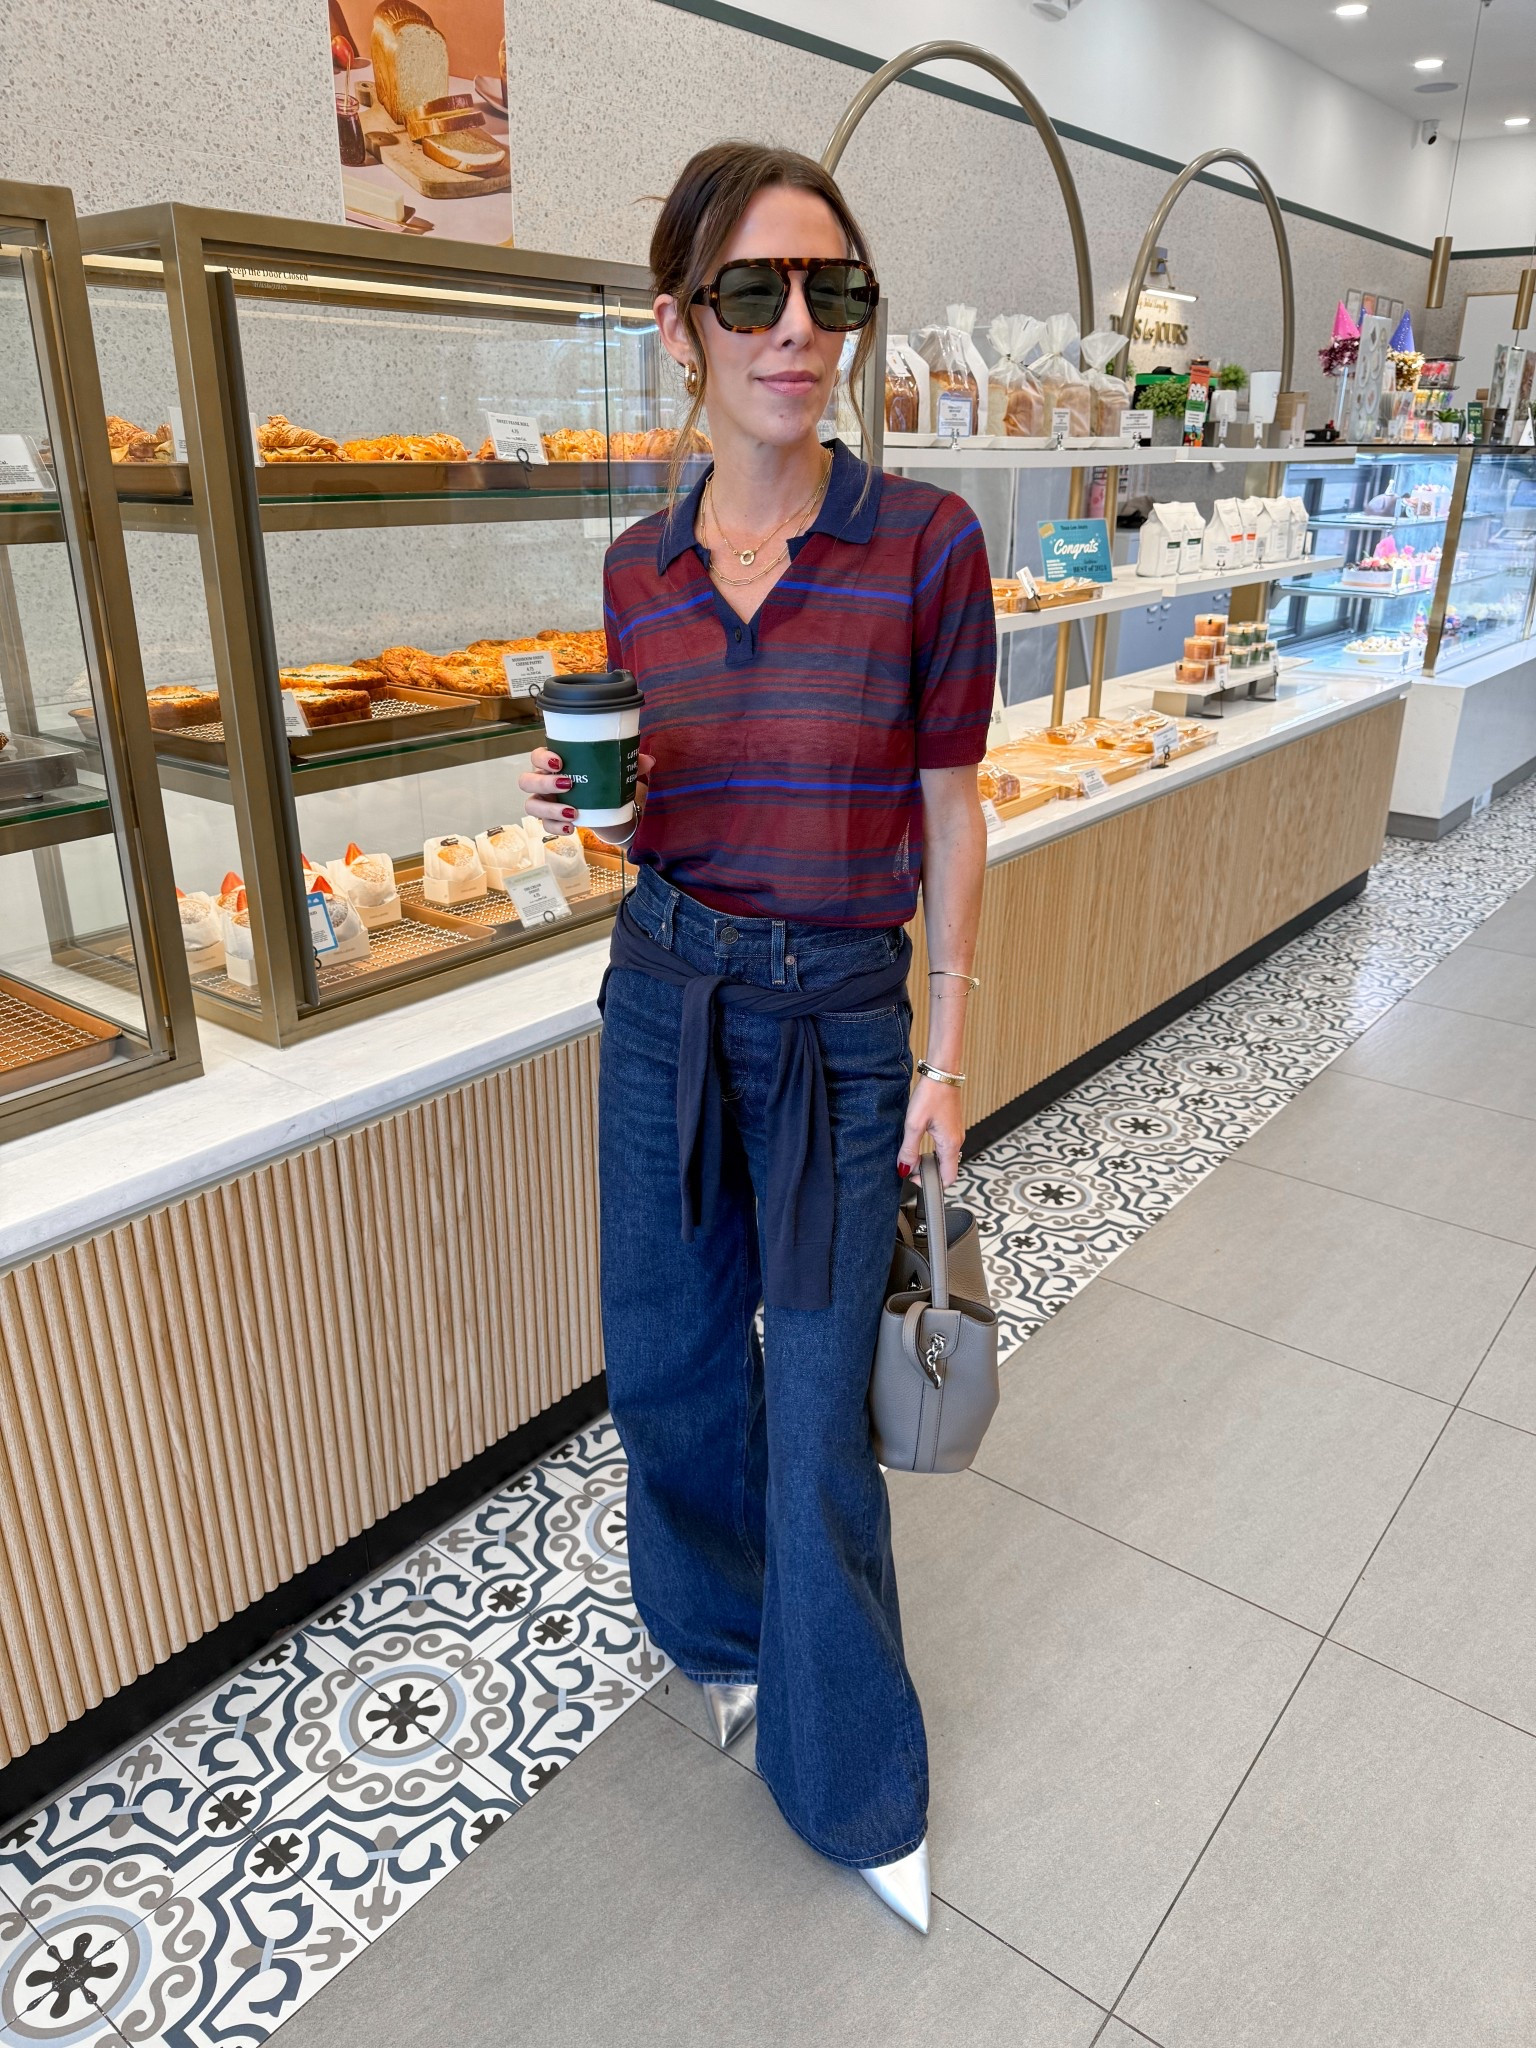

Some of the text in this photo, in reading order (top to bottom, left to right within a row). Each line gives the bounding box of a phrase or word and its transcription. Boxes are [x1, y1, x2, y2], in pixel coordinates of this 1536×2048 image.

[226, 266, 247, 277] Keep
[263, 269, 282, 279] Door
[284, 271, 309, 281] Closed
[1053, 538, 1099, 560] Congrats
